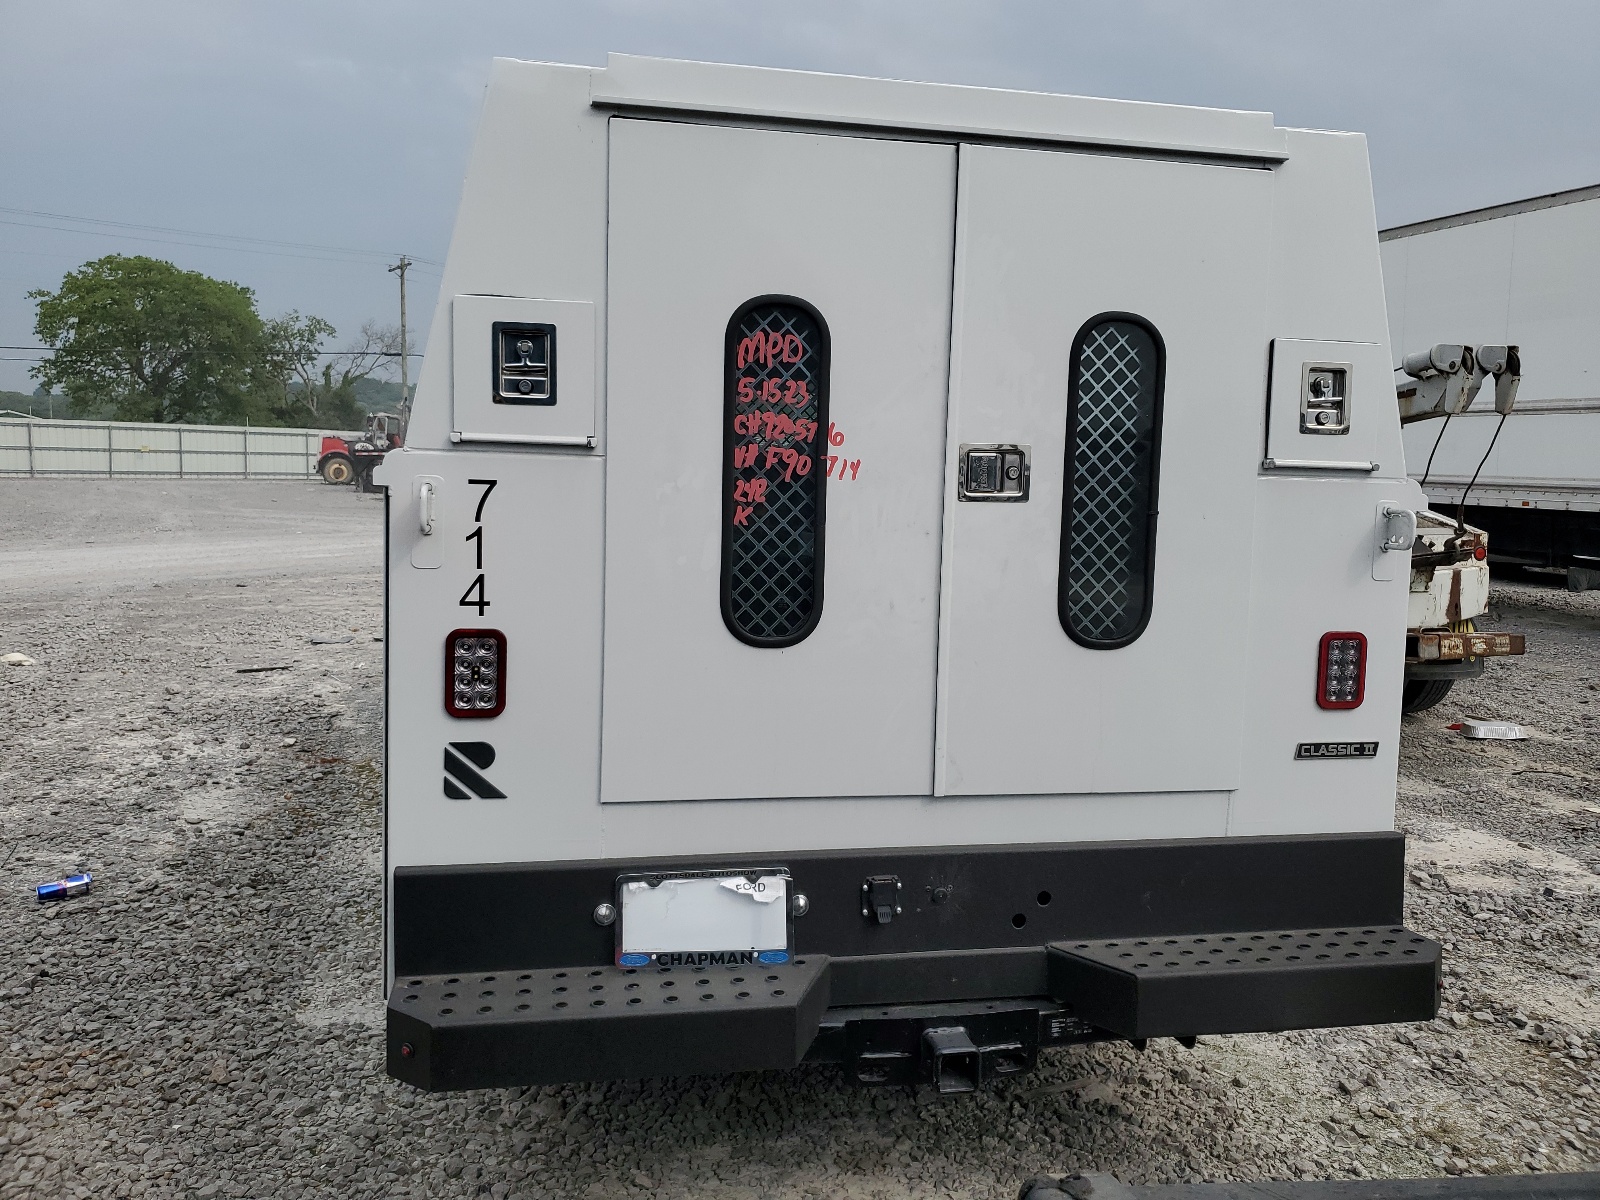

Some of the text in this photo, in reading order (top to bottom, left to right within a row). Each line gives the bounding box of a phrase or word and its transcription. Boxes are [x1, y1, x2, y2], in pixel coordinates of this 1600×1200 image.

[737, 331, 803, 368] MPD
[734, 505, 754, 526] K
[1300, 743, 1375, 756] CLASSIC II
[709, 869, 757, 878] AUTOSHOW
[656, 951, 754, 967] CHAPMAN
